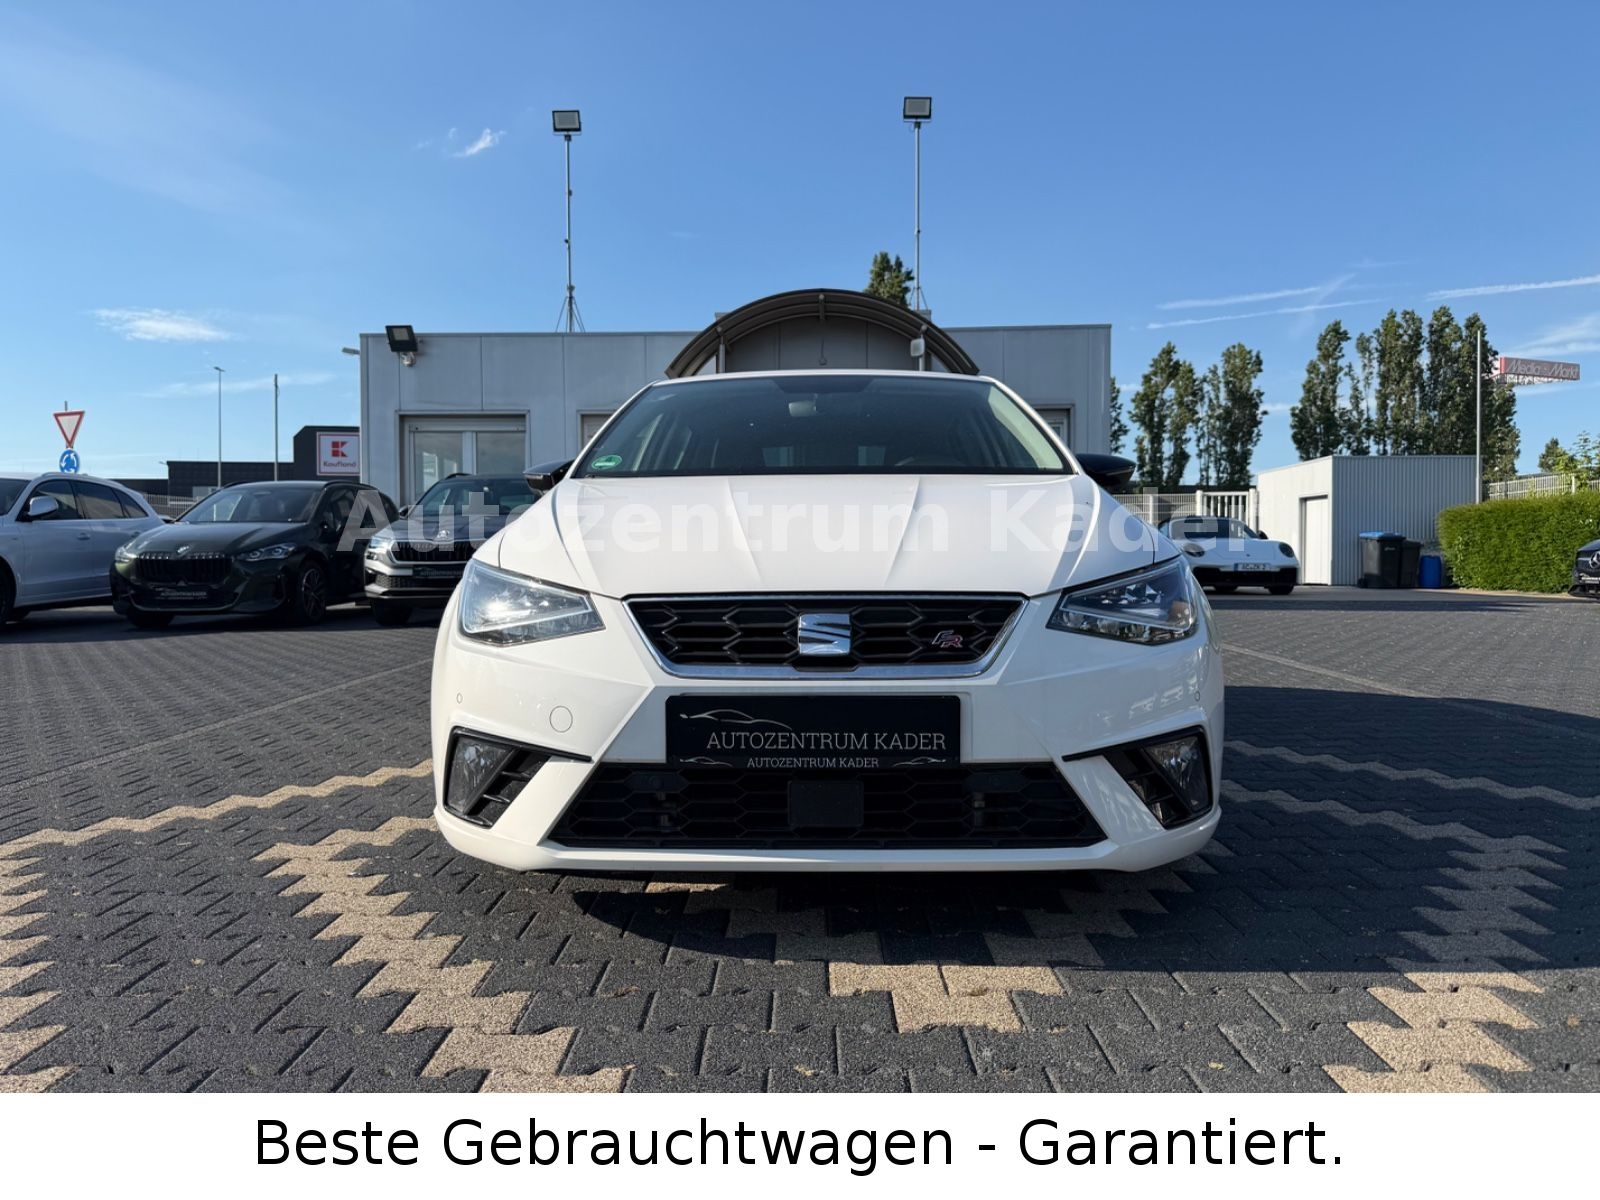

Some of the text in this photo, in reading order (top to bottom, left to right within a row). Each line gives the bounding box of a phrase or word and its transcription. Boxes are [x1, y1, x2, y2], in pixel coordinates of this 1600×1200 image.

[706, 732, 947, 750] AUTOZENTRUM KADER
[747, 757, 879, 768] AUTOZENTRUM KADER
